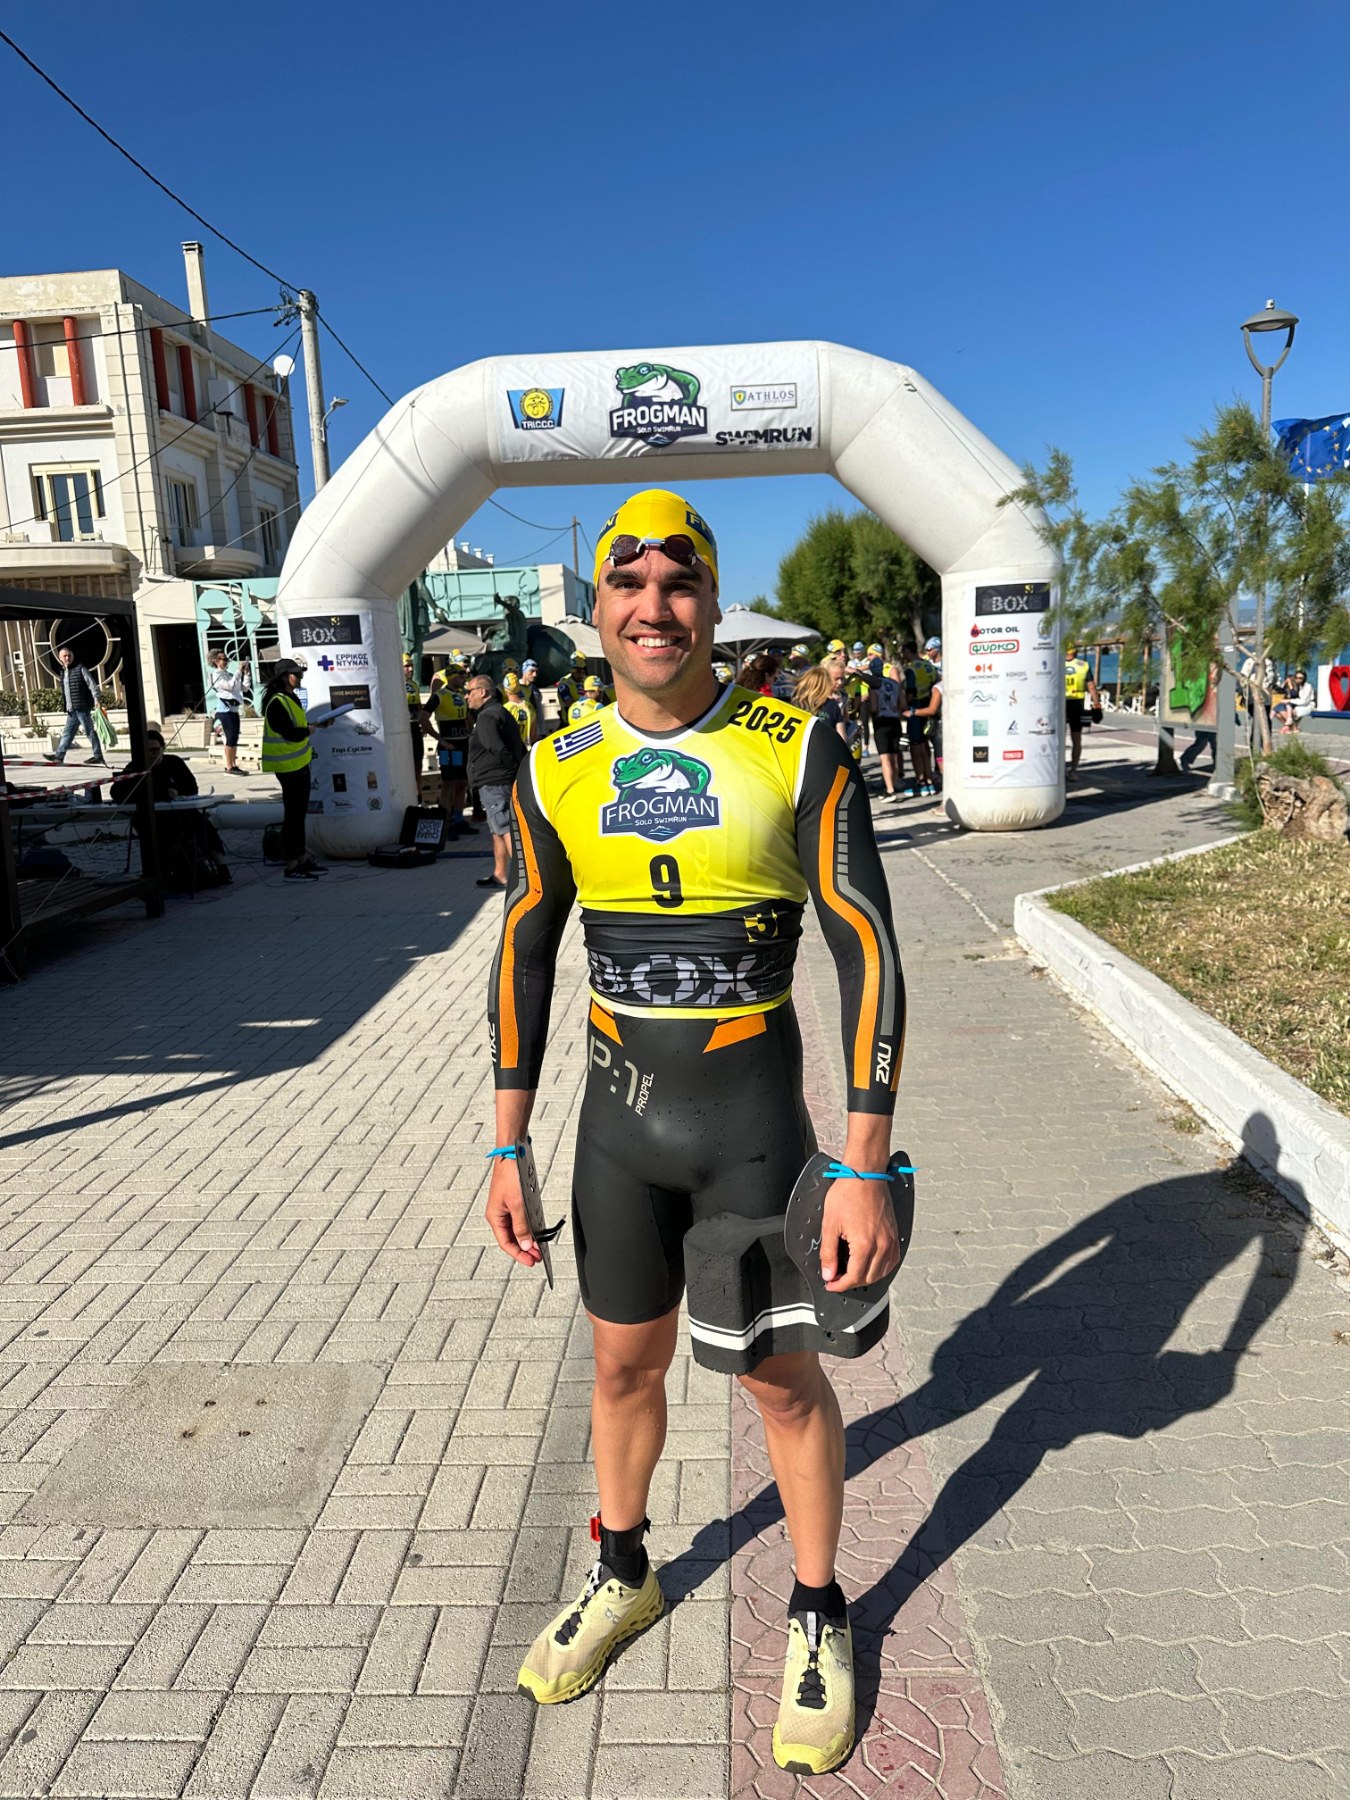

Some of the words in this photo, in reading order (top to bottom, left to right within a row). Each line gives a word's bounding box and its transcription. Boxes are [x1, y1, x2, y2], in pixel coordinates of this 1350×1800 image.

[747, 390, 794, 401] ATHLOS
[612, 404, 705, 431] FROGMAN
[636, 426, 652, 434] SOLO
[653, 425, 682, 433] SWIMRUN
[715, 427, 812, 446] SWIMRUN
[991, 596, 1029, 612] BOX
[302, 627, 337, 644] BOX
[727, 700, 803, 744] 2025
[606, 796, 715, 826] FROGMAN
[635, 818, 653, 827] SOLO
[654, 816, 687, 825] SWIMRUN
[649, 854, 684, 909] 9
[876, 1041, 892, 1085] 2XU
[635, 1073, 655, 1117] PROPEL
